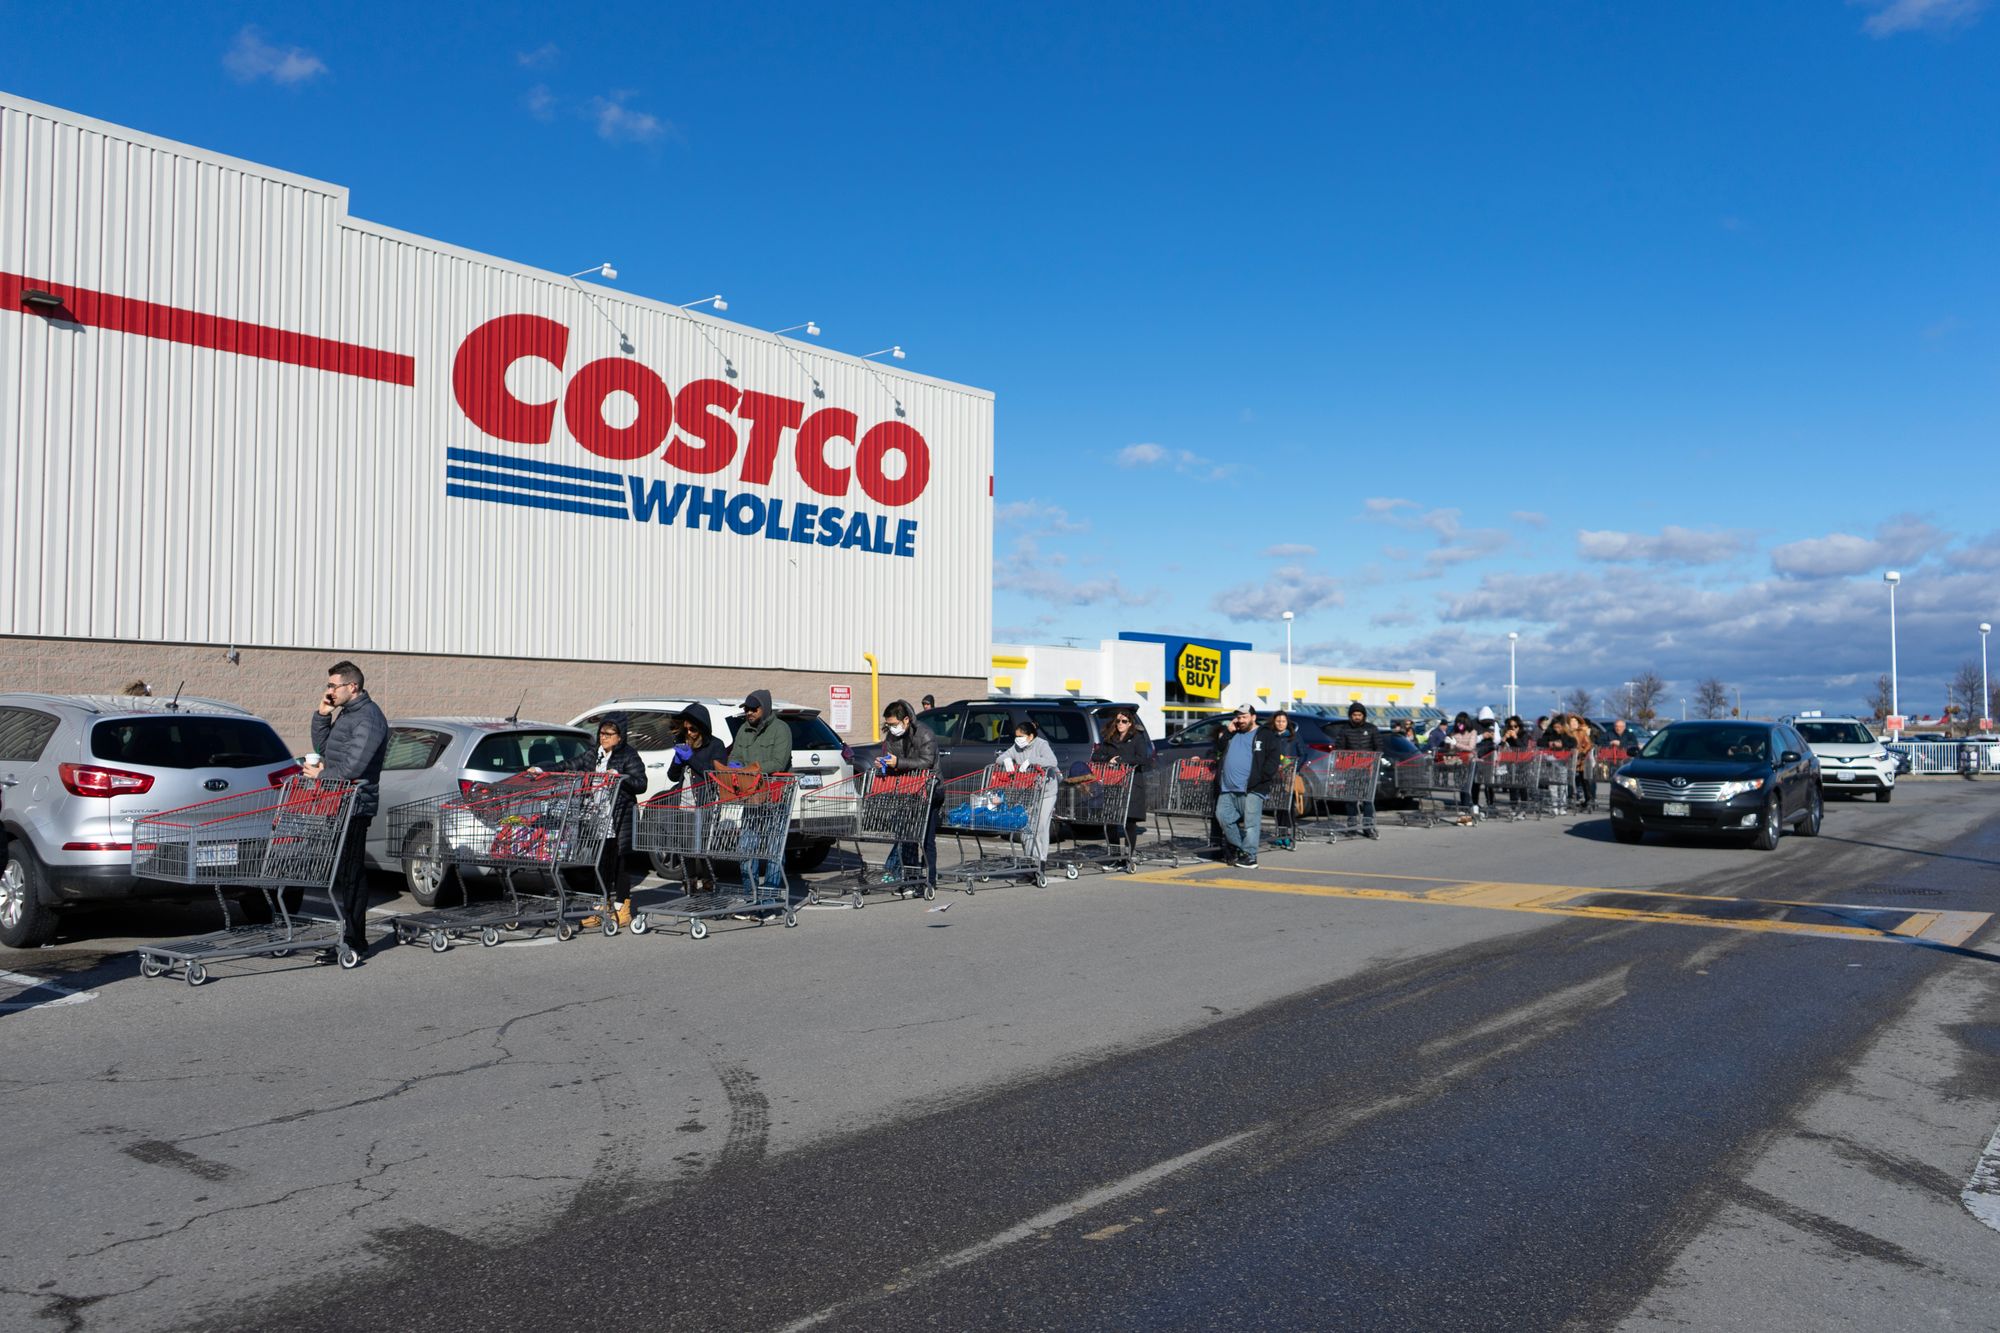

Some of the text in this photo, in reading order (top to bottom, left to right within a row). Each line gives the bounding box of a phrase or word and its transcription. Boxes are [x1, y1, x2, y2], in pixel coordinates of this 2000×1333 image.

[452, 313, 930, 507] COSTCO
[628, 475, 918, 557] WHOLESALE
[1185, 653, 1219, 674] BEST
[1186, 670, 1216, 689] BUY
[208, 780, 226, 789] KIA
